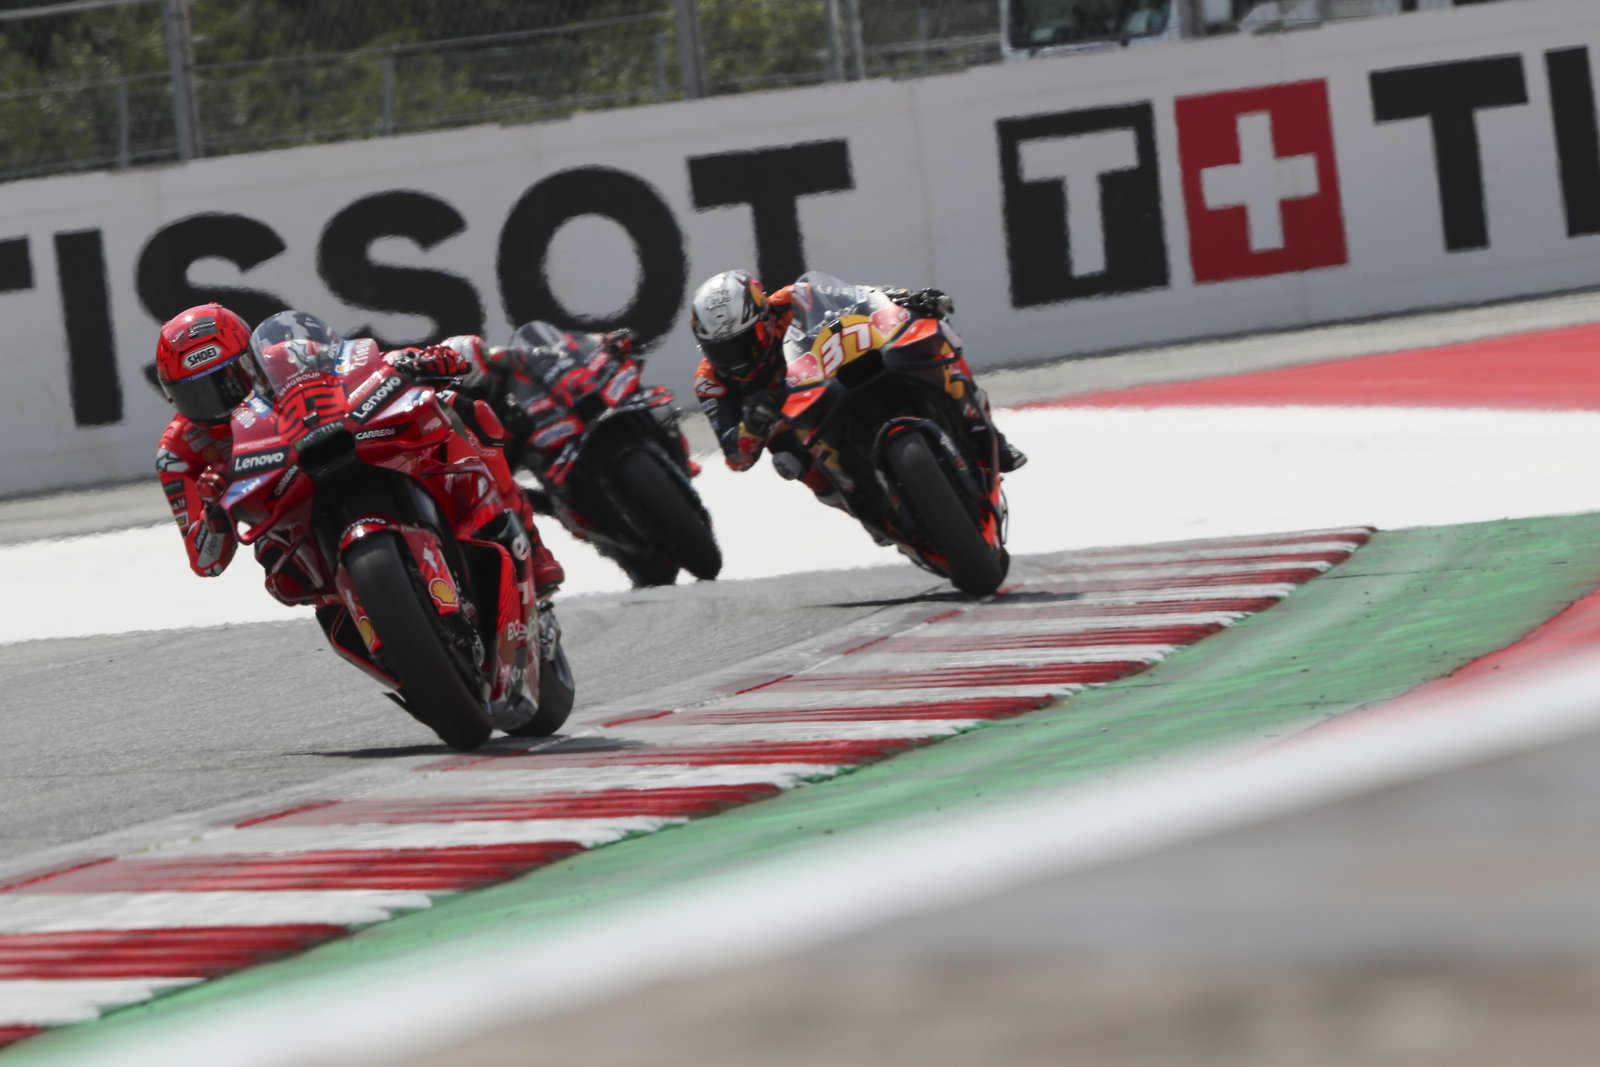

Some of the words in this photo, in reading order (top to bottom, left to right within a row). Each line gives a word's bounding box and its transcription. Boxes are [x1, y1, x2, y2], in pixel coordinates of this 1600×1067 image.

[1018, 128, 1139, 278] T
[0, 138, 854, 428] ISSOT
[187, 347, 218, 367] SHOEI
[821, 321, 873, 378] 37
[352, 376, 402, 419] Lenovo
[355, 428, 396, 440] CARRERA
[234, 452, 285, 472] Lenovo
